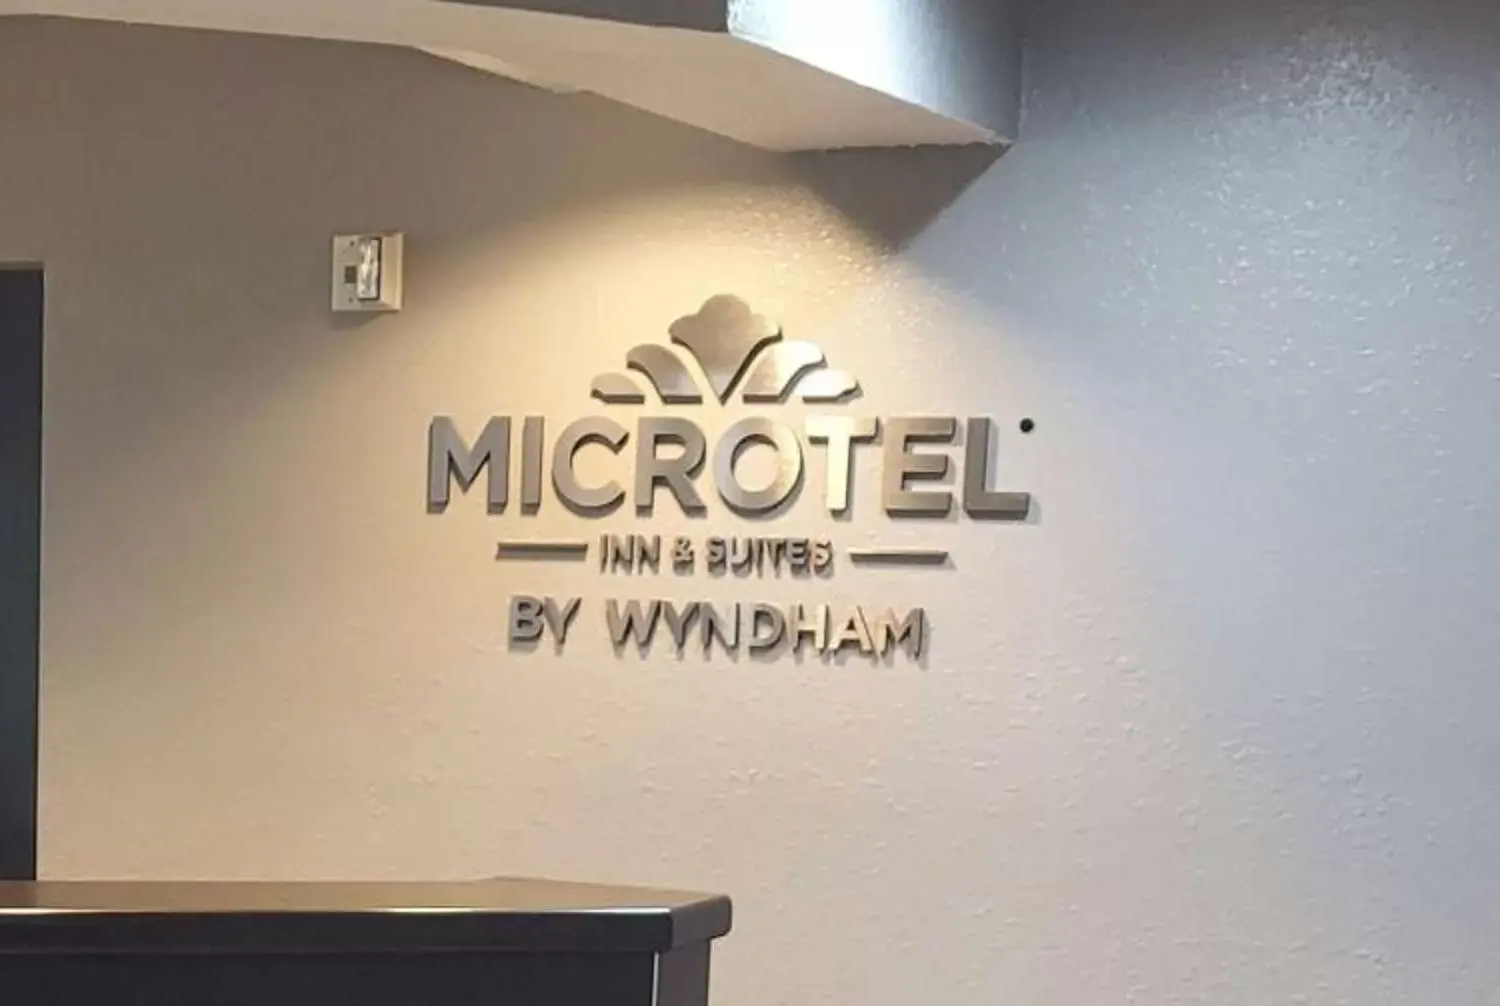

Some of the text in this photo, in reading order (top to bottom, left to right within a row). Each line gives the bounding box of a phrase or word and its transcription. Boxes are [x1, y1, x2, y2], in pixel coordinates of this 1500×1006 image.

[426, 416, 1031, 518] MICROTEL
[599, 534, 834, 577] INN & SUITES
[508, 594, 928, 667] BY WYNDHAM
